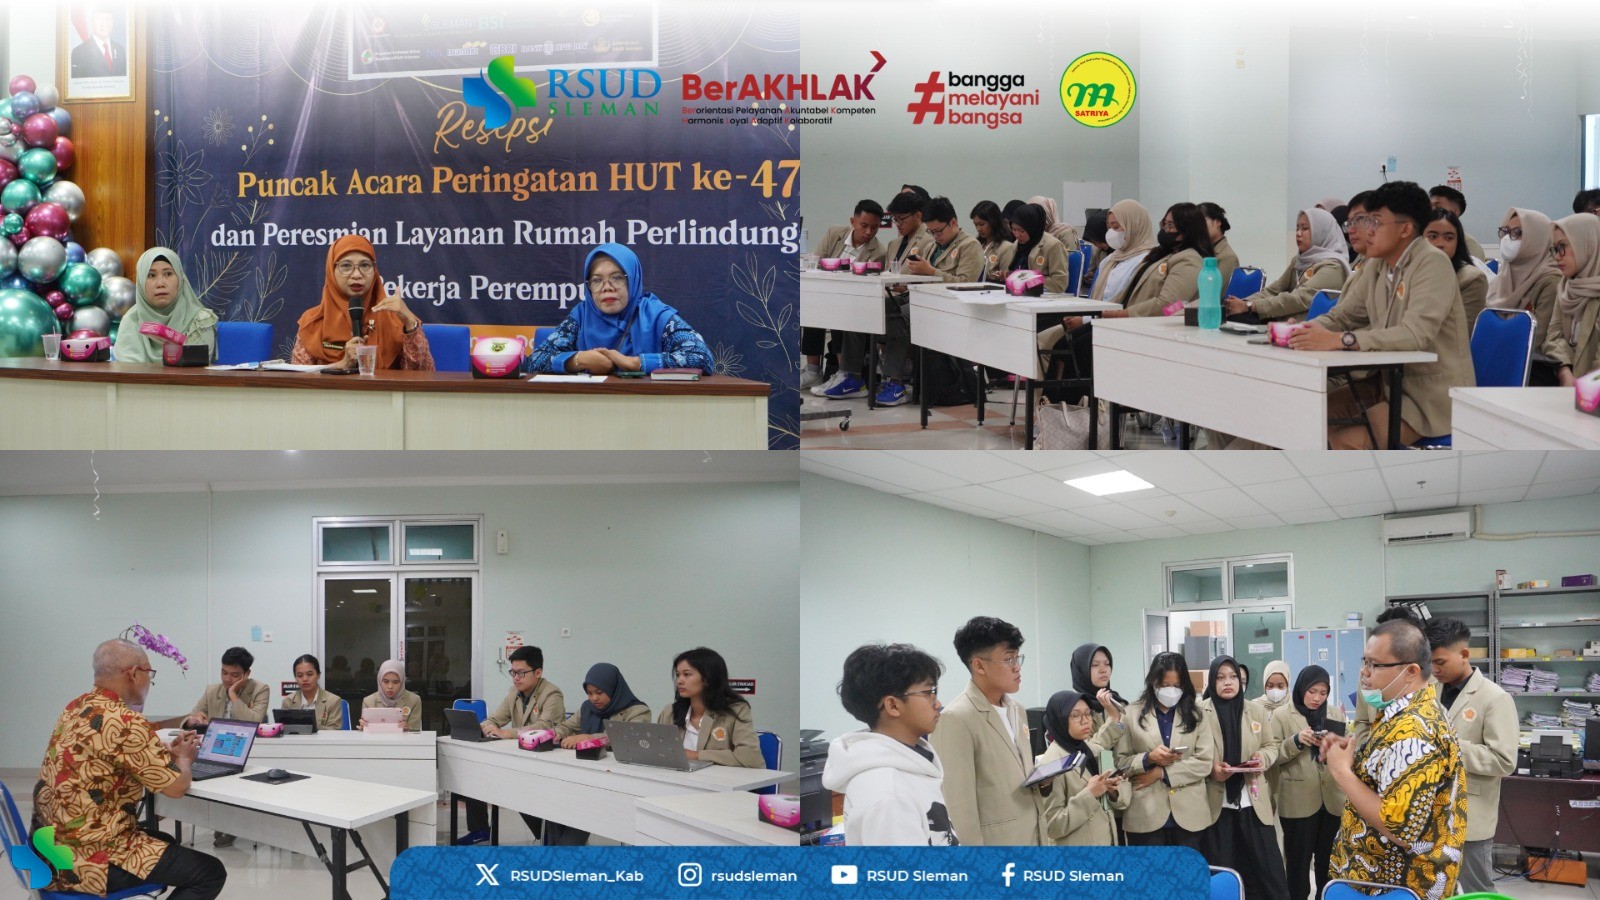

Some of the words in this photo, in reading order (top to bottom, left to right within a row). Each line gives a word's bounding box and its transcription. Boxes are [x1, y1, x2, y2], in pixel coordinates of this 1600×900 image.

[237, 169, 339, 198] Puncak
[346, 168, 423, 195] Acara
[431, 165, 599, 202] Peringatan
[608, 161, 682, 191] HUT
[691, 159, 800, 198] ke-47
[211, 223, 256, 247] dan
[262, 221, 389, 246] Peresmian
[395, 220, 504, 253] Layanan
[513, 219, 616, 245] Rumah
[626, 219, 800, 254] Perlindung
[380, 274, 462, 307] ekerja
